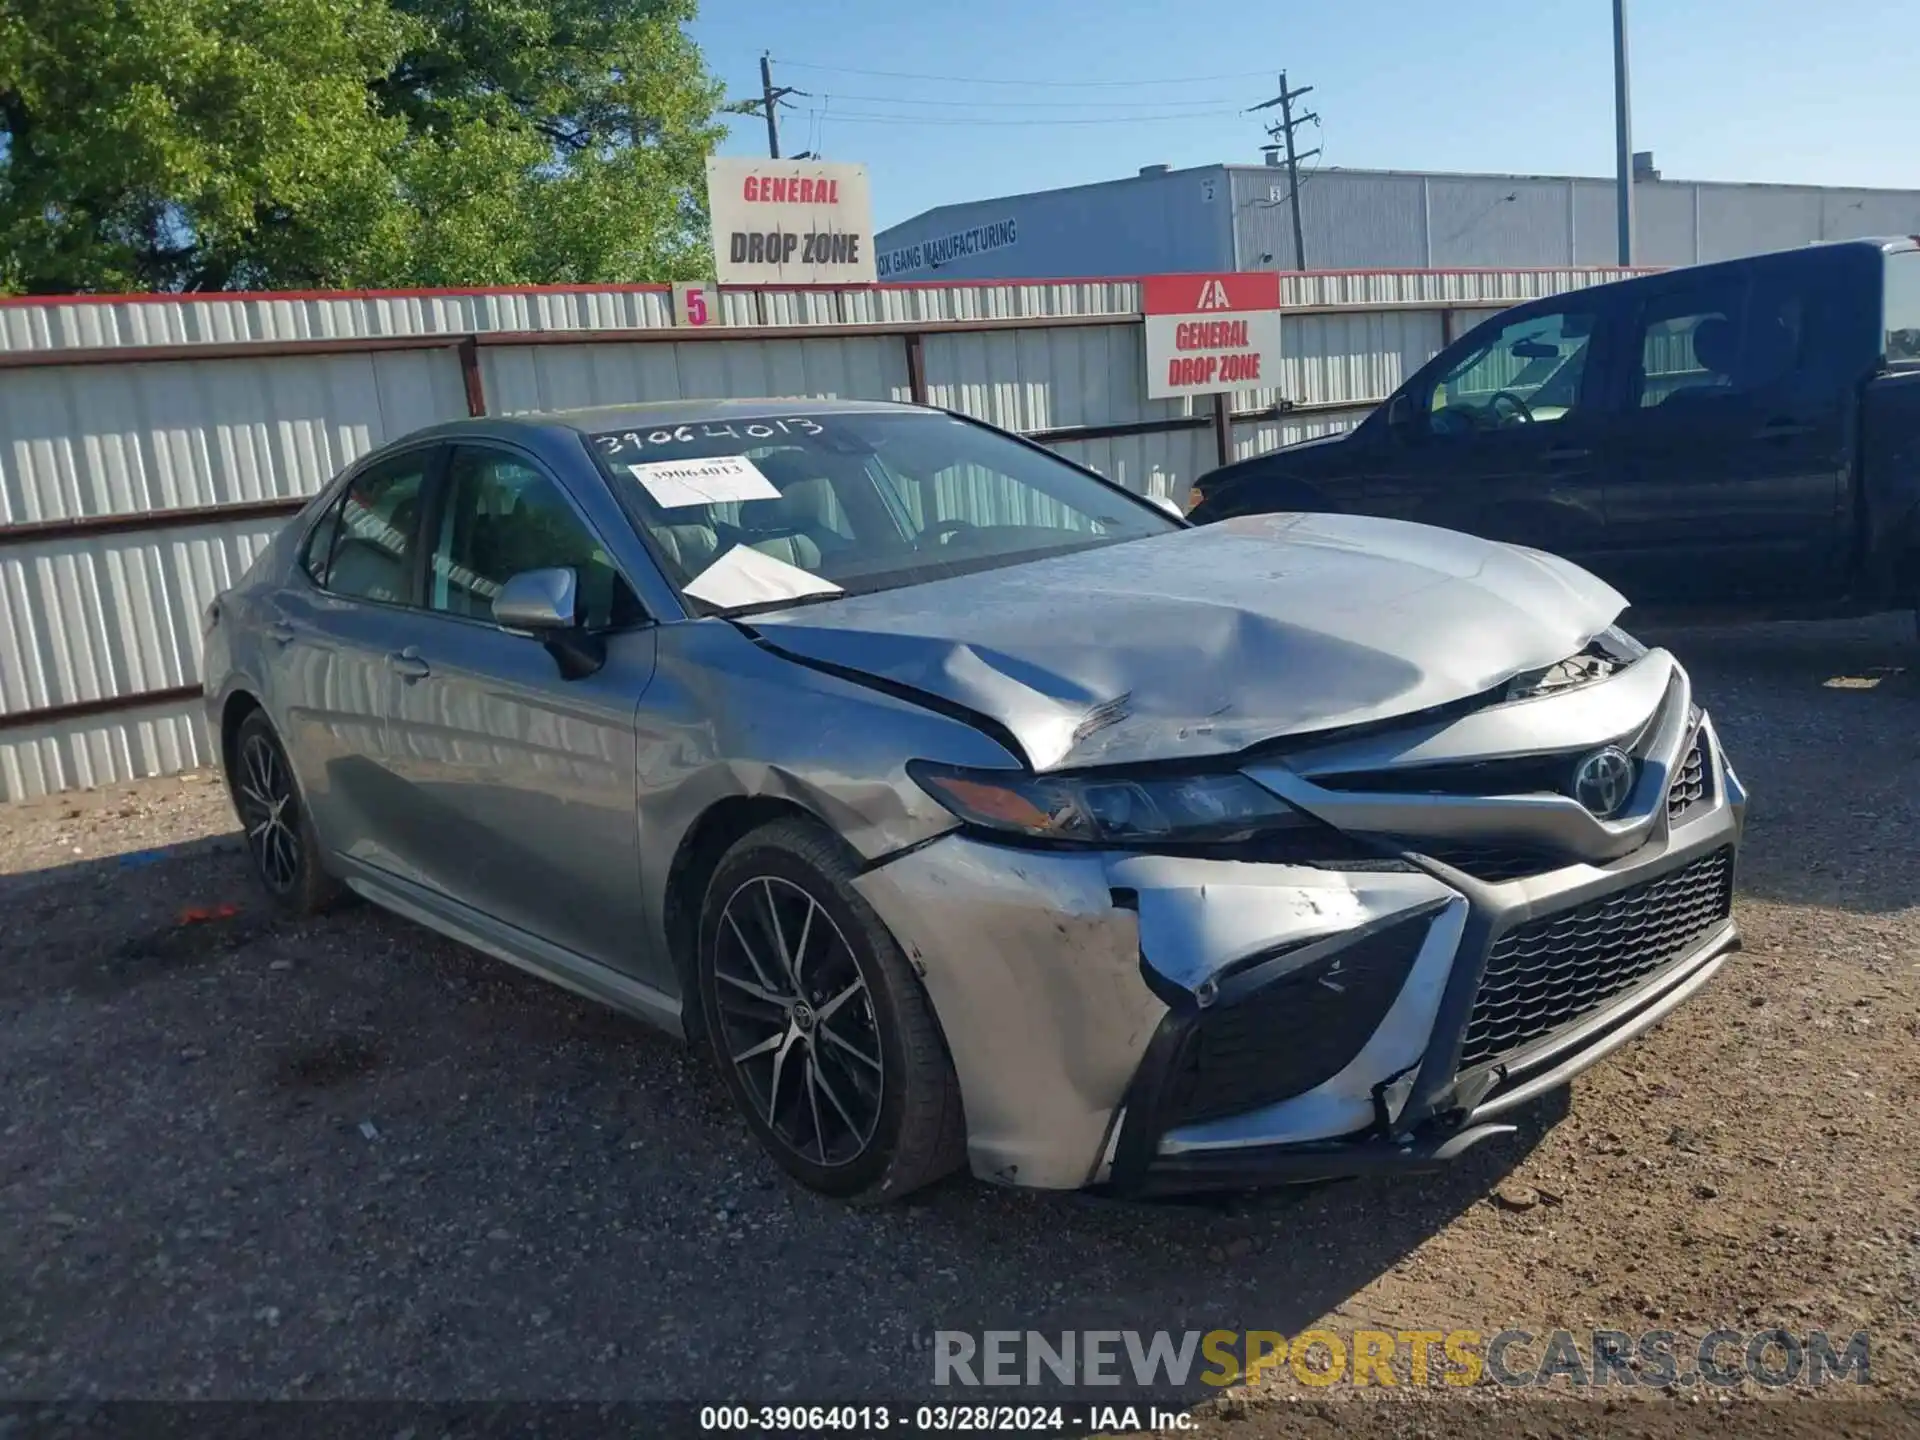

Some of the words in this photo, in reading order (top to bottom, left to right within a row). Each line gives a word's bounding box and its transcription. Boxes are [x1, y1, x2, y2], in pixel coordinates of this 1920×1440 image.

[743, 175, 839, 205] GENERAL
[730, 231, 798, 265] DROP
[802, 231, 860, 265] ZONE
[893, 246, 921, 273] GANG
[923, 219, 1016, 265] MANUFACTURING
[686, 288, 708, 326] 5
[1175, 319, 1250, 352] GENERAL
[1168, 355, 1217, 387] DROP
[1218, 353, 1261, 382] ZONE
[651, 464, 744, 480] 39064013
